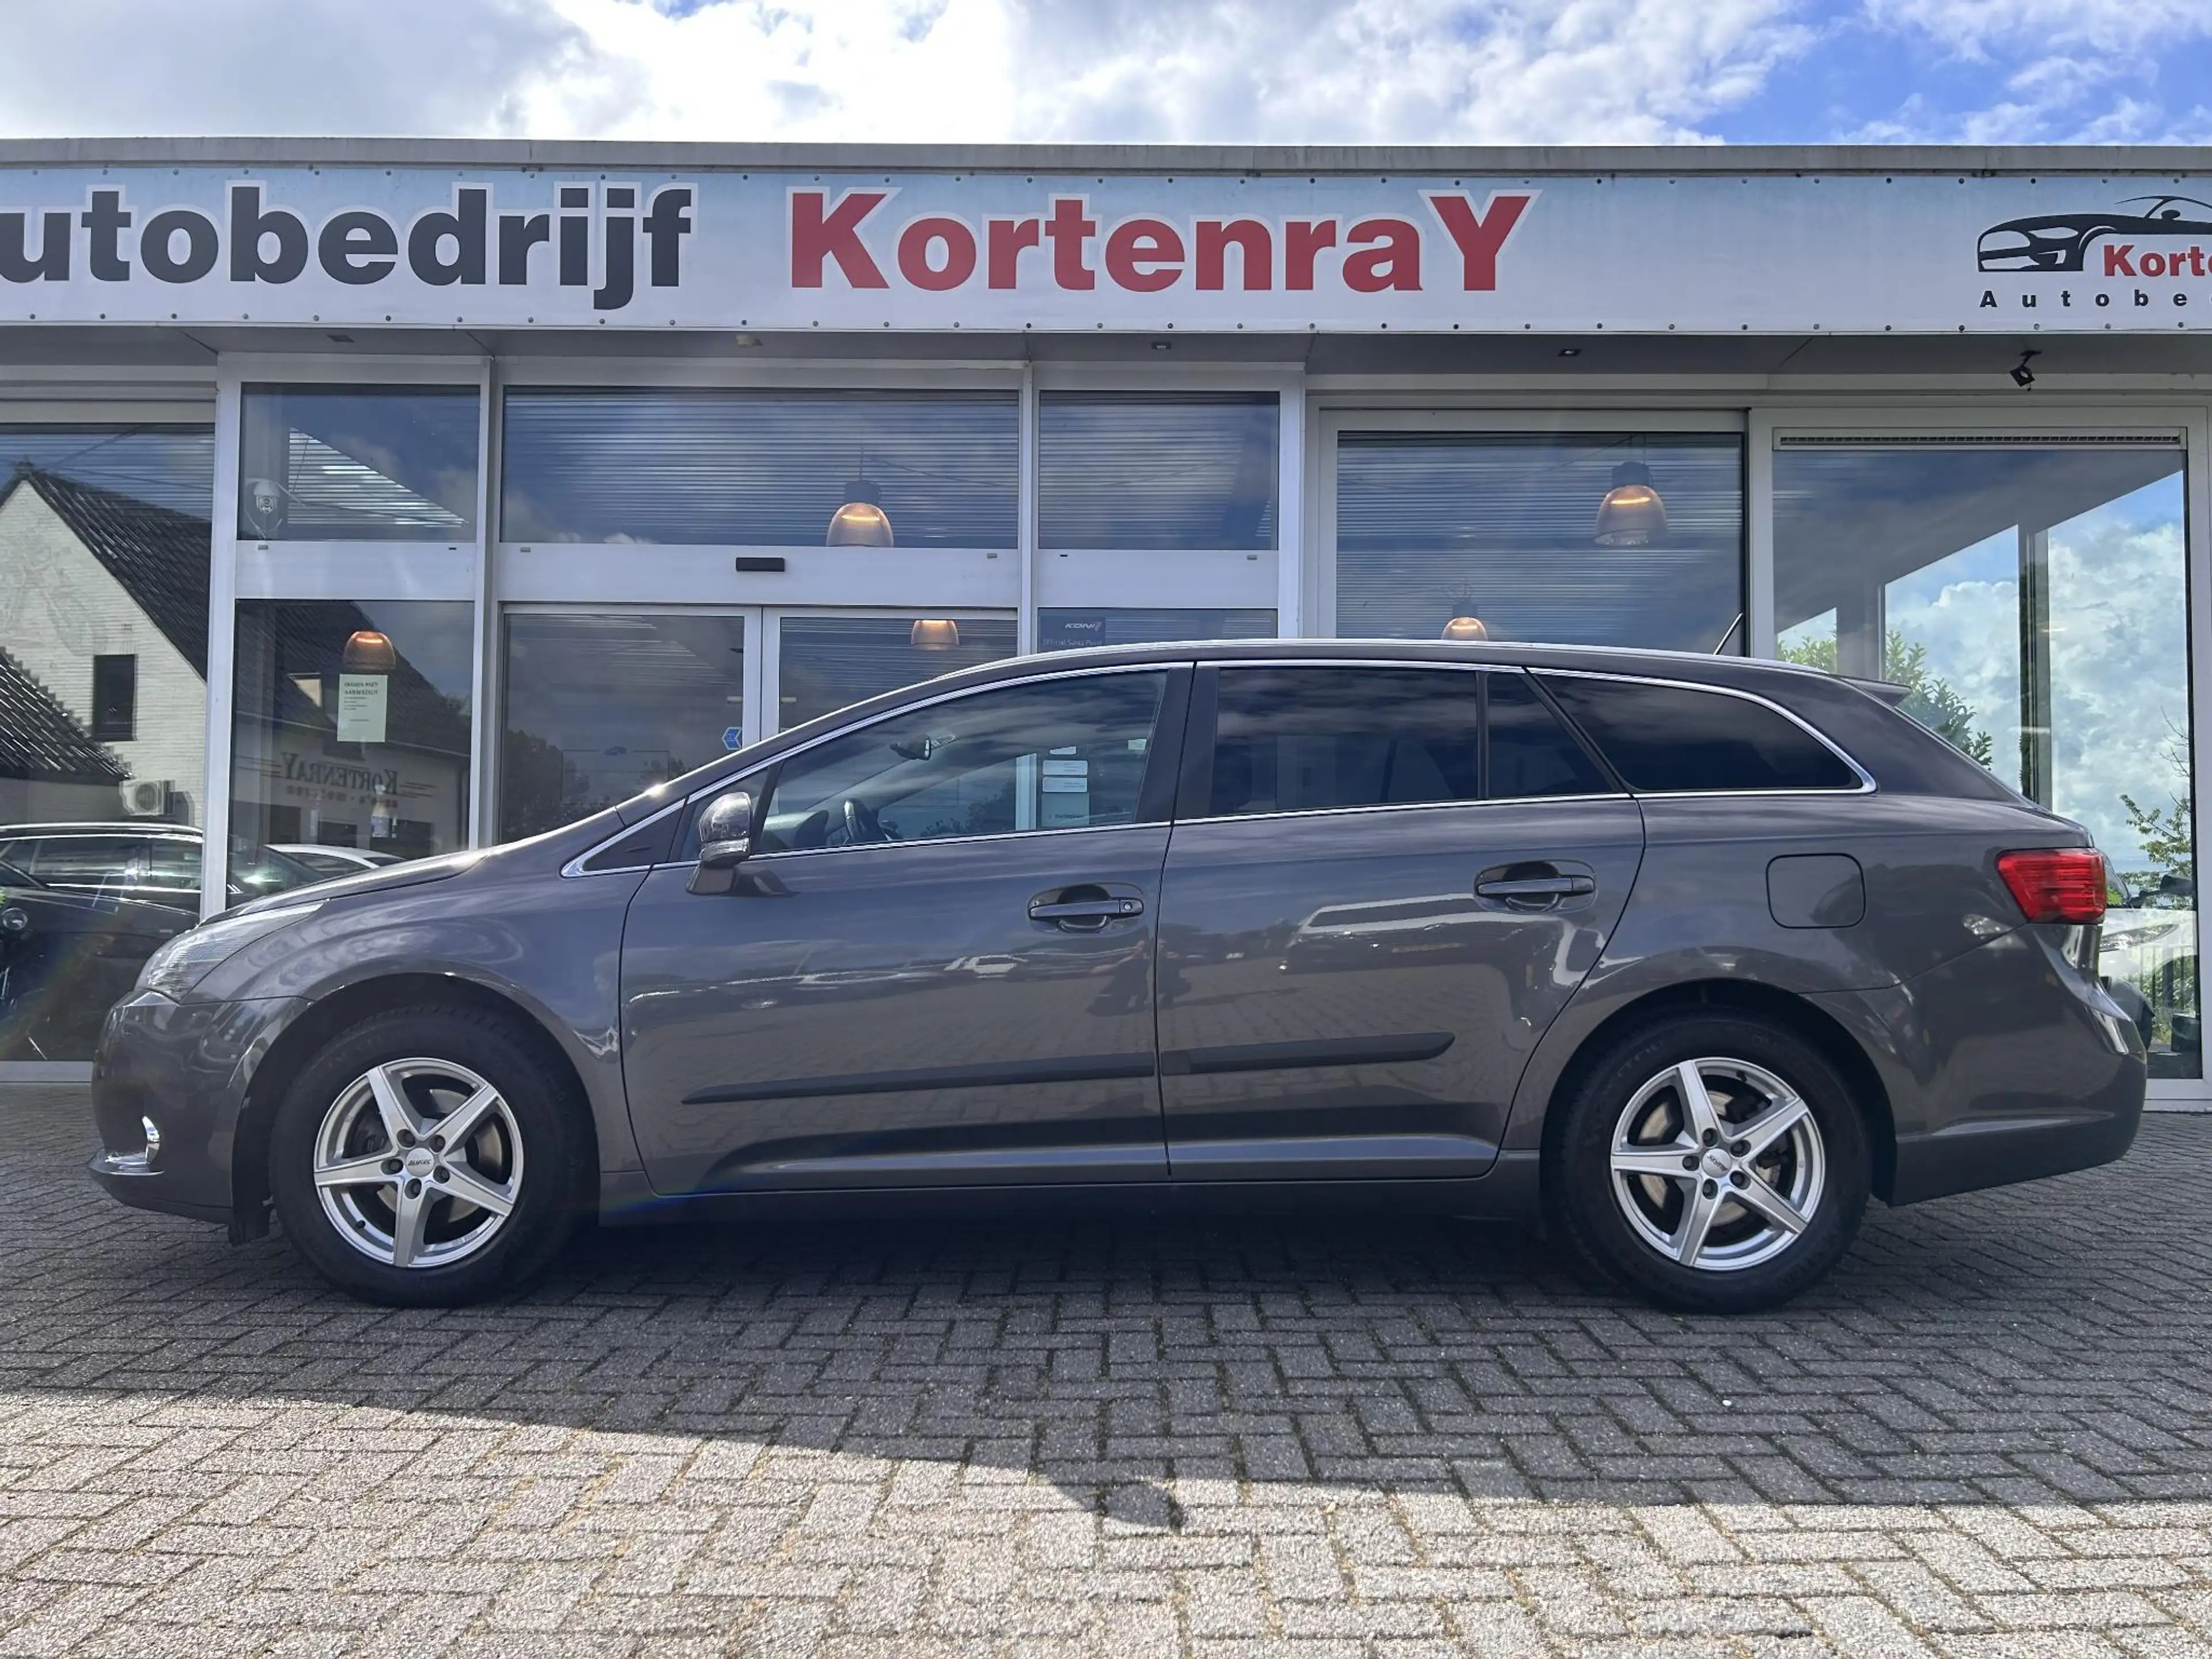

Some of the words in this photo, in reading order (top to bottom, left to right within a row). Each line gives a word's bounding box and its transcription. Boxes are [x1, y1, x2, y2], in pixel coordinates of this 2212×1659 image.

[791, 192, 1532, 293] KortenraY
[2103, 244, 2212, 277] Kort
[1979, 289, 2212, 308] Autobe
